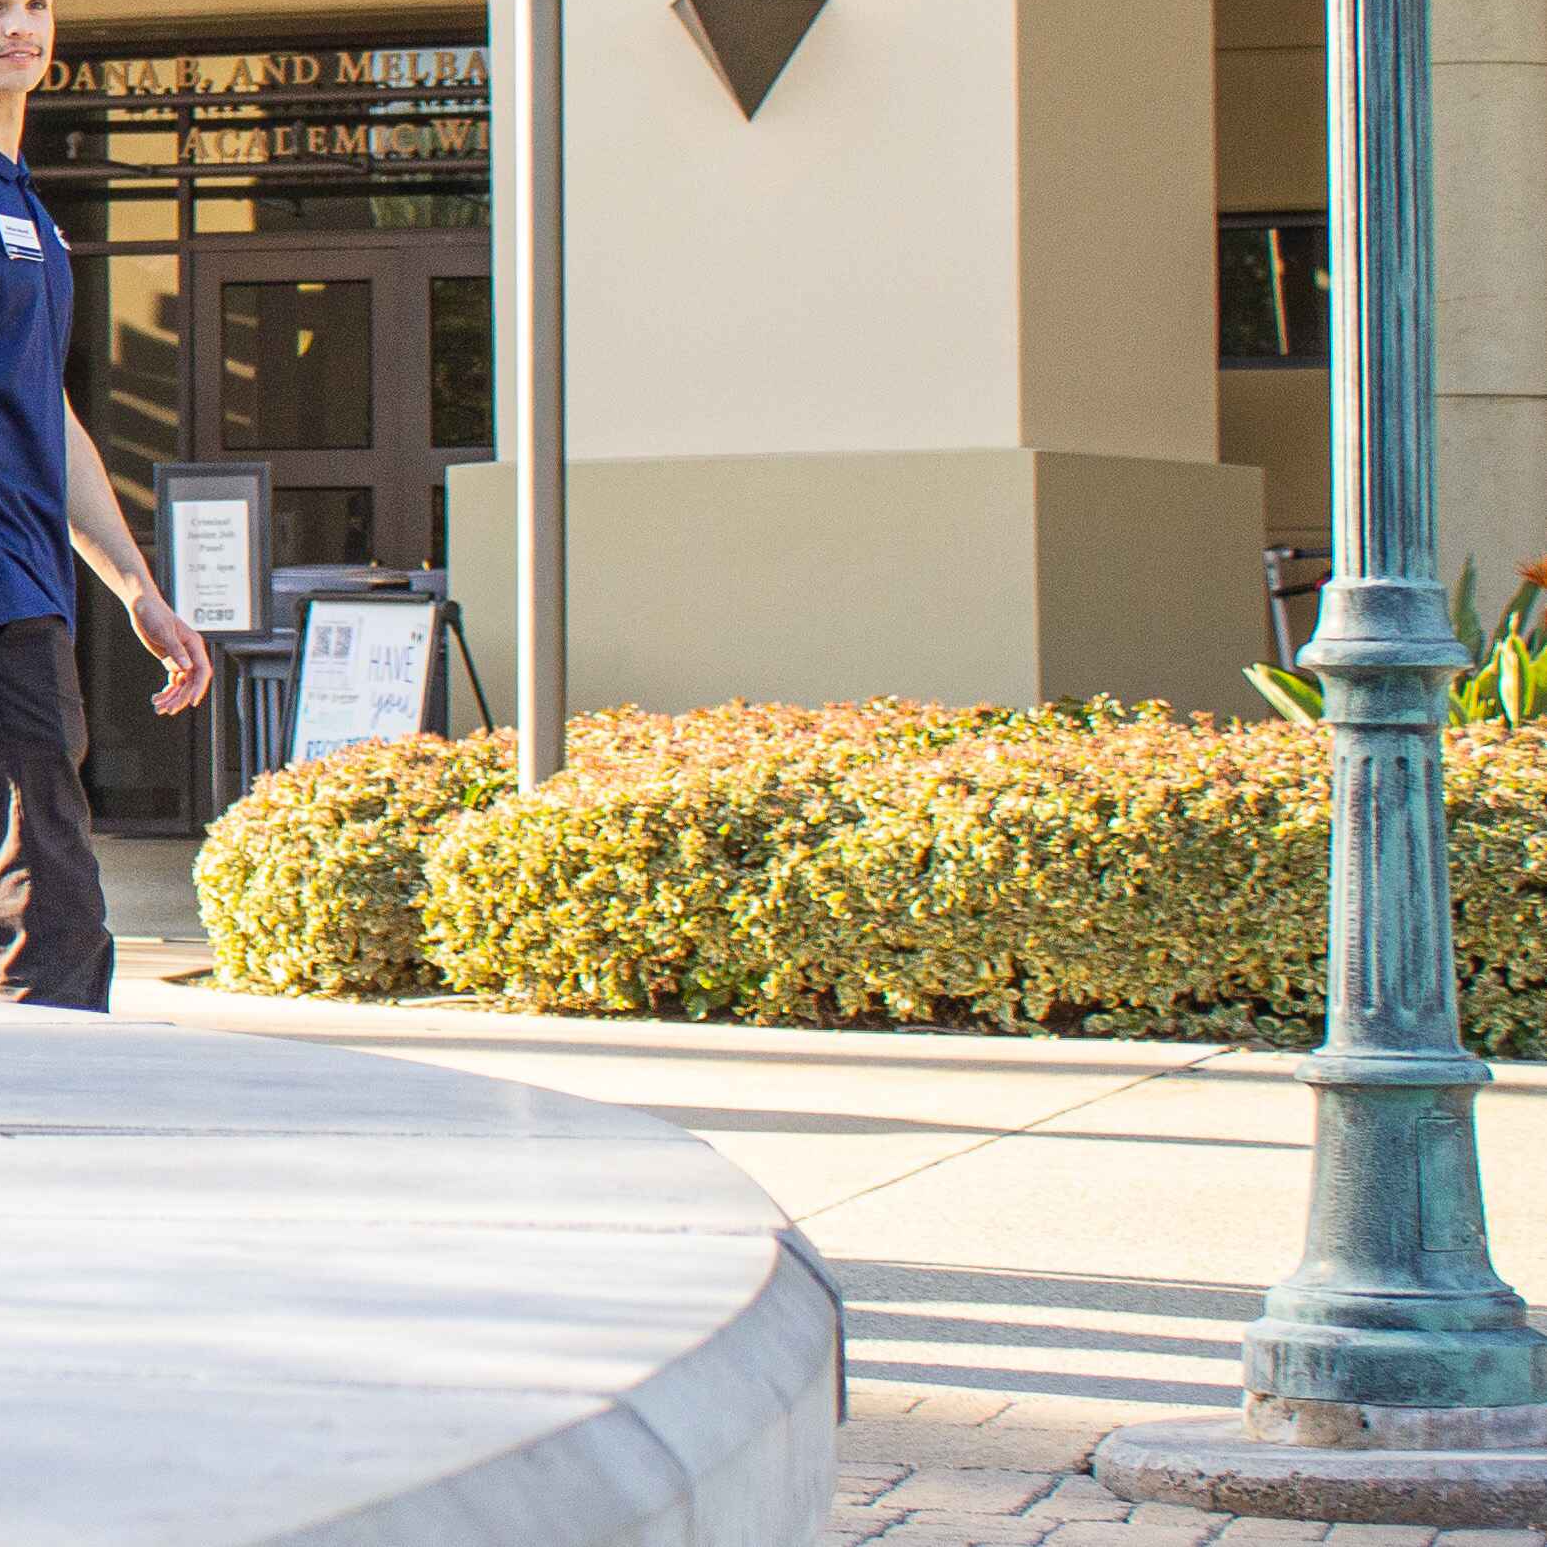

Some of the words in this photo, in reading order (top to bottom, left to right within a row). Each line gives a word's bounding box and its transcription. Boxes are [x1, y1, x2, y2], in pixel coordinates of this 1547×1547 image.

[39, 59, 160, 91] DANA
[175, 56, 213, 89] B.
[227, 52, 322, 88] AND
[335, 49, 489, 85] MELBA
[180, 123, 420, 159] ACADEMIC
[427, 119, 490, 152] WI
